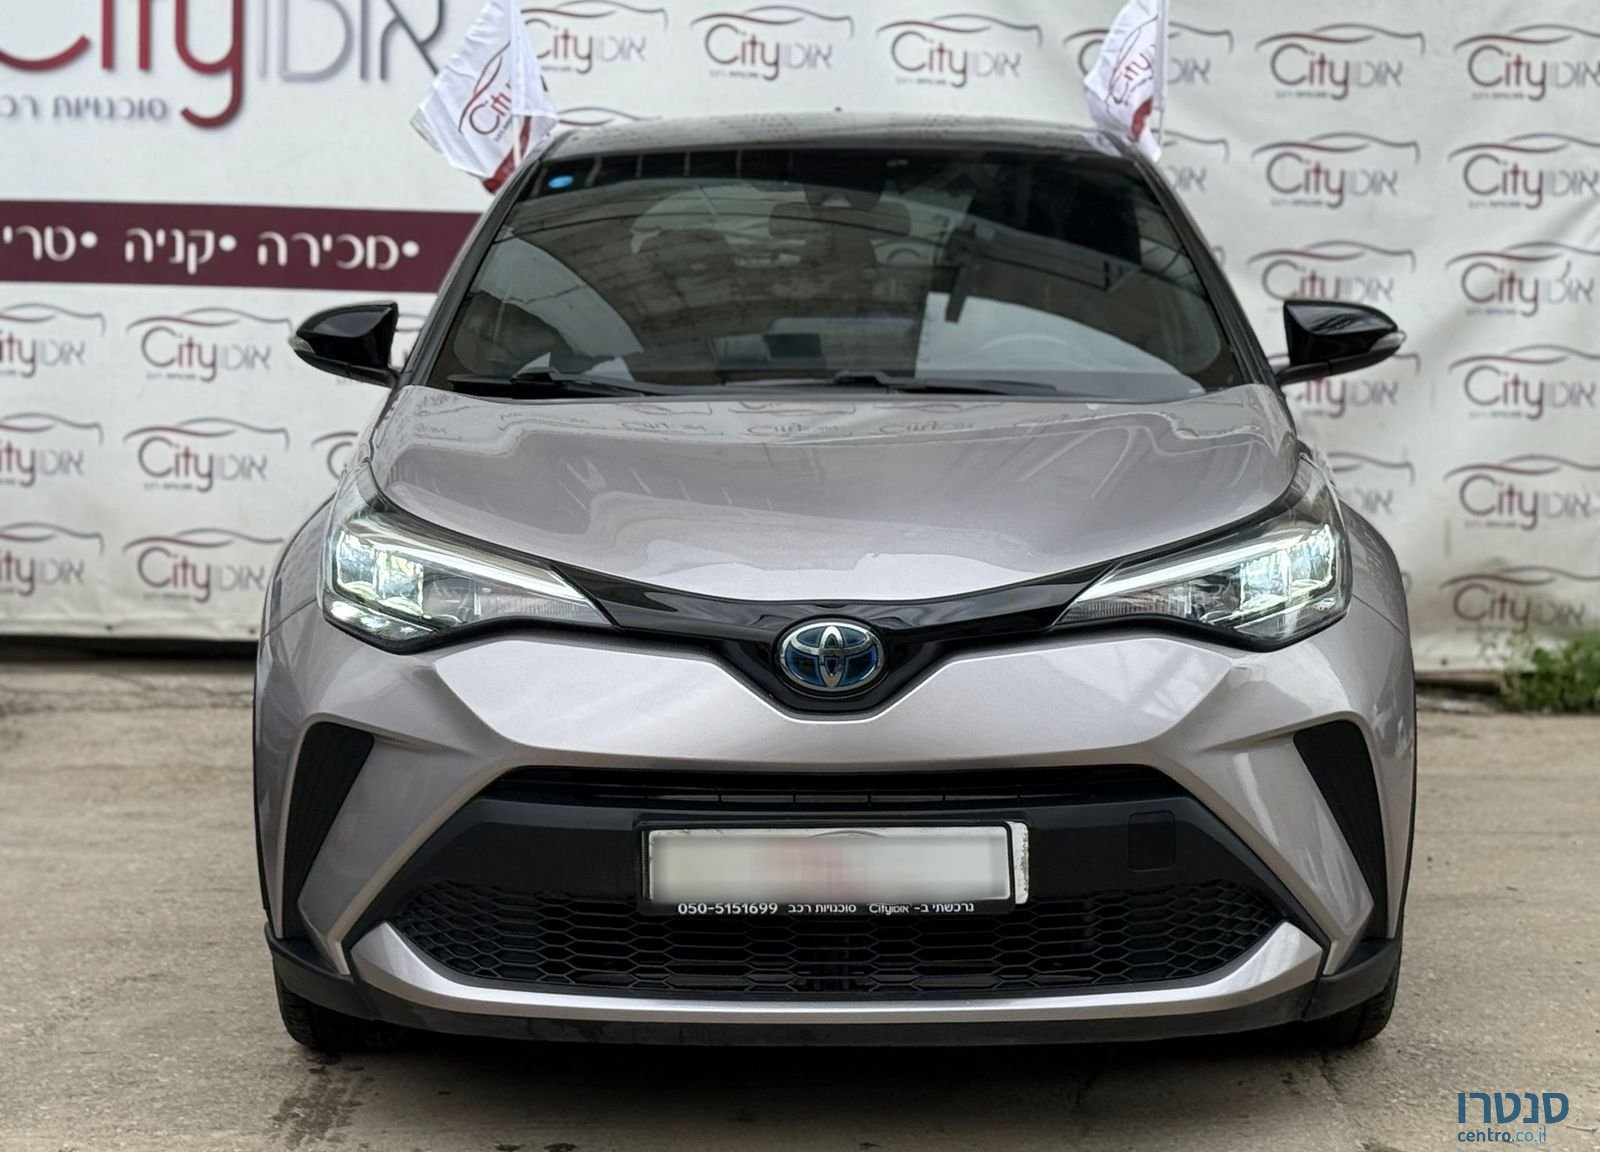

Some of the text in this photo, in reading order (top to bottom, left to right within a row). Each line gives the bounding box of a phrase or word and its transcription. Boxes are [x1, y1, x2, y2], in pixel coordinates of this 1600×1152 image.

[125, 228, 215, 275] קניה
[257, 231, 399, 270] מכירה
[1295, 376, 1346, 419] ity
[677, 902, 778, 914] 050-5151699
[788, 904, 812, 913] רכב
[932, 902, 974, 912] נרכשתי
